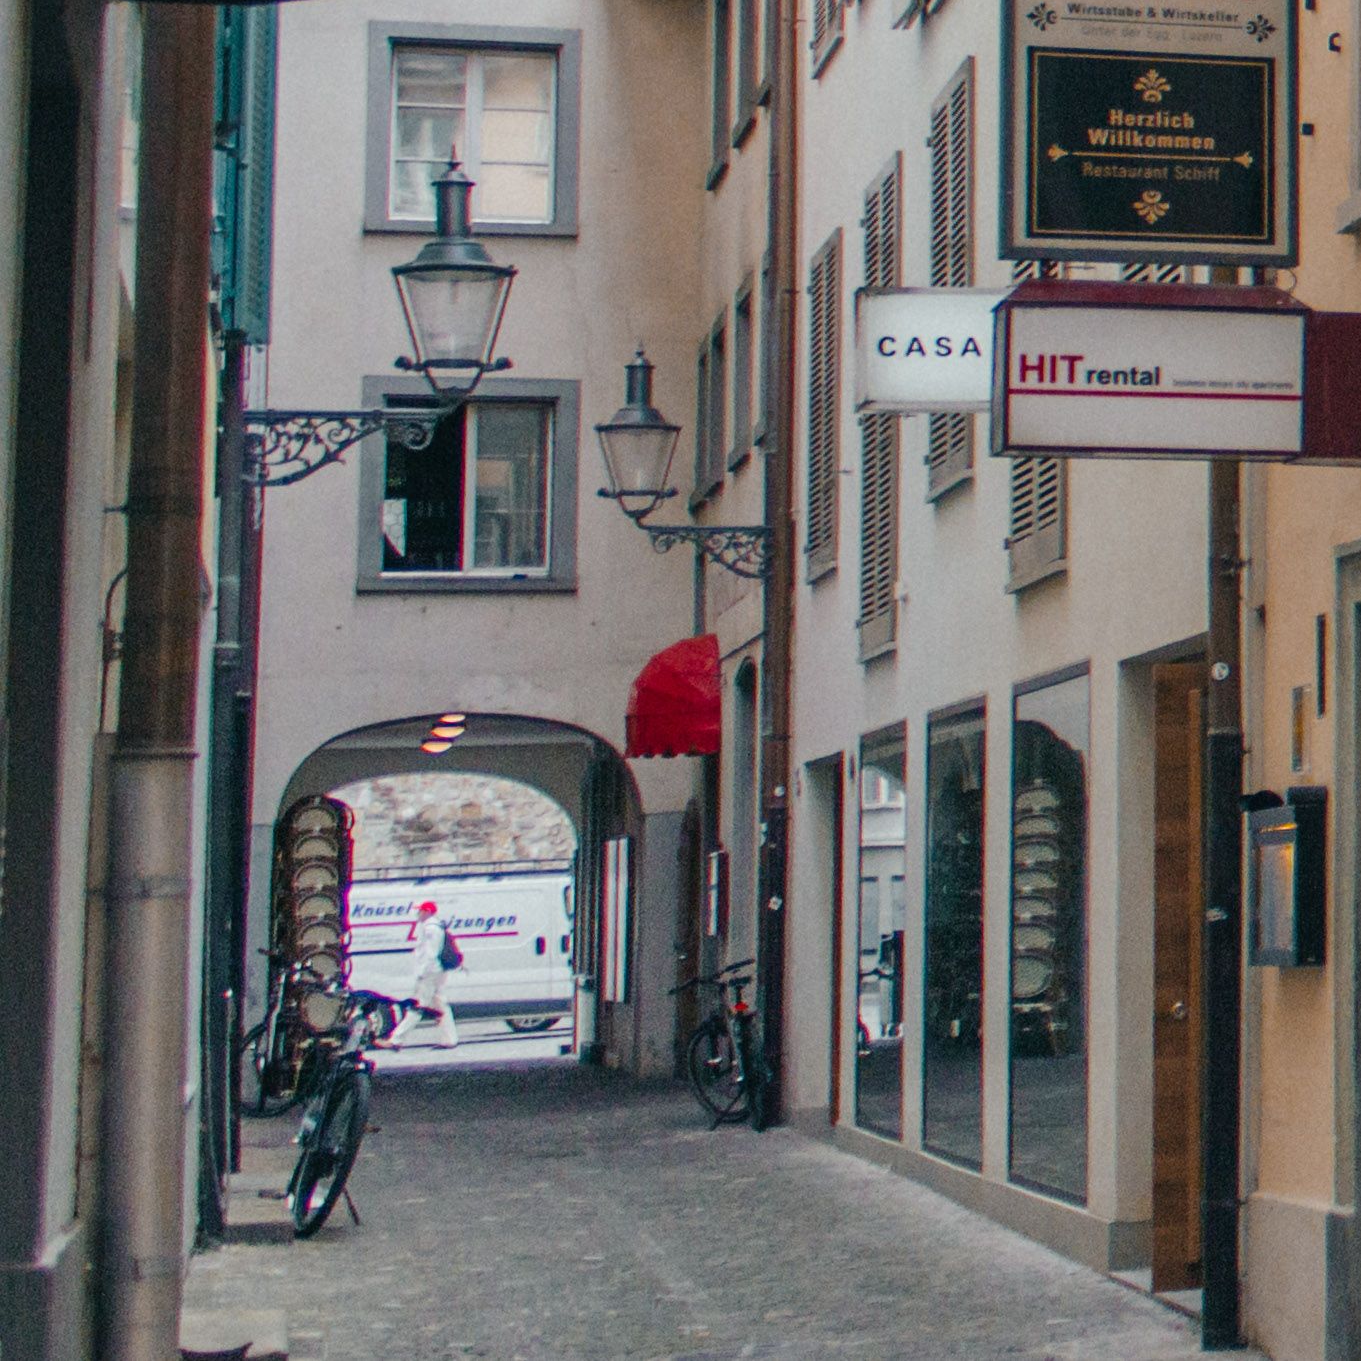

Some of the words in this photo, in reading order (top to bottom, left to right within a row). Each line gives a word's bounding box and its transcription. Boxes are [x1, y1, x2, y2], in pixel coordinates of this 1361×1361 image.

[1067, 3, 1141, 18] Wirtsstube
[1162, 8, 1238, 23] Wirtskeller
[1109, 109, 1195, 129] Herzlich
[1087, 128, 1215, 150] Willkommen
[1082, 161, 1168, 179] Restaurant
[1174, 166, 1220, 182] Schiff
[878, 336, 982, 357] CASA
[1086, 366, 1161, 386] rental
[352, 902, 413, 917] Knüsel
